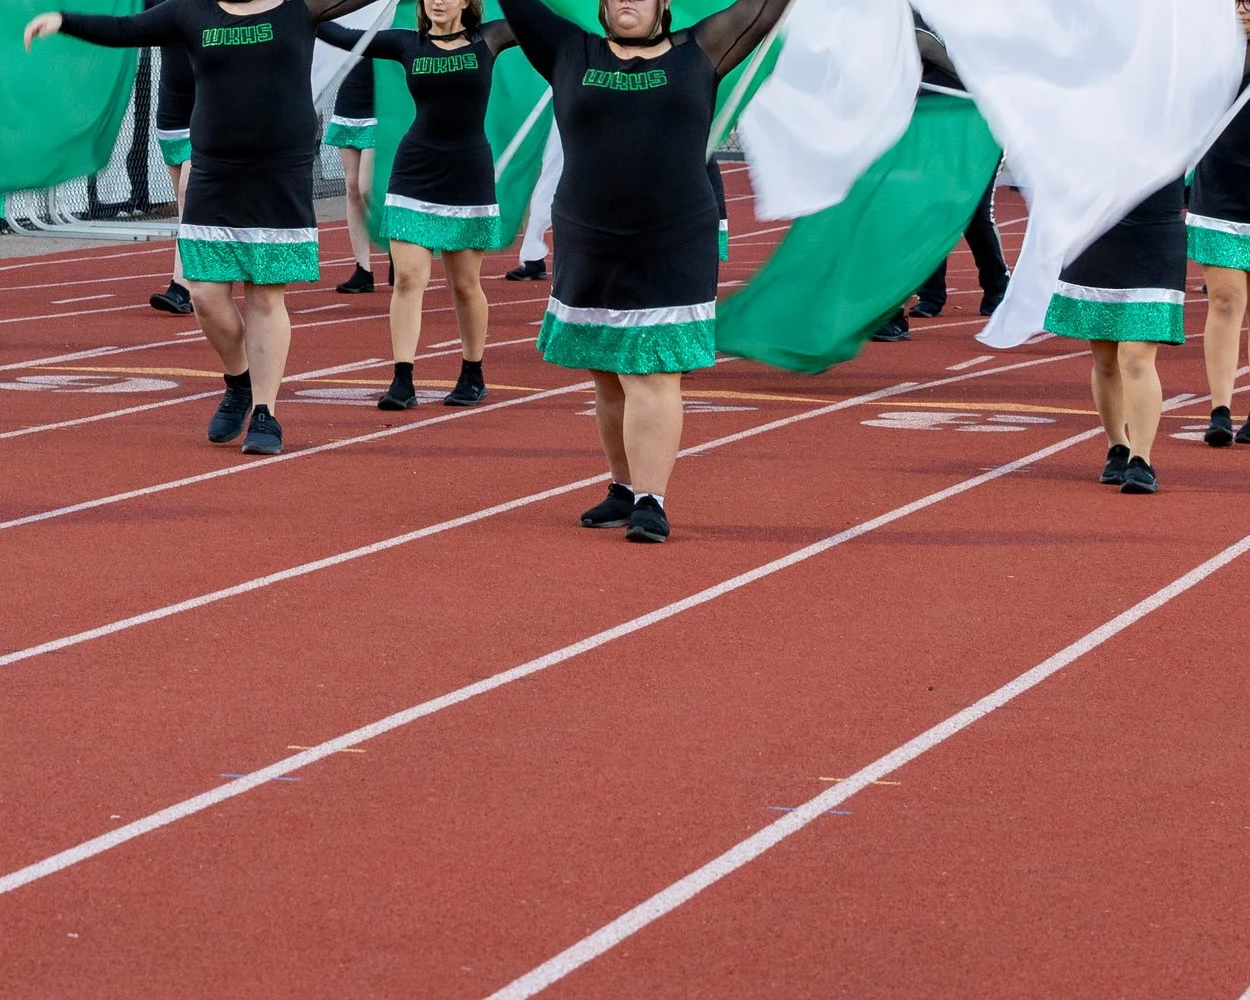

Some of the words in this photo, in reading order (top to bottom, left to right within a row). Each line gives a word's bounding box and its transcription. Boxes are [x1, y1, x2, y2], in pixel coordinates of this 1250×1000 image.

[202, 23, 273, 47] WKHS
[412, 53, 478, 75] WKHS
[582, 69, 667, 91] WKHS
